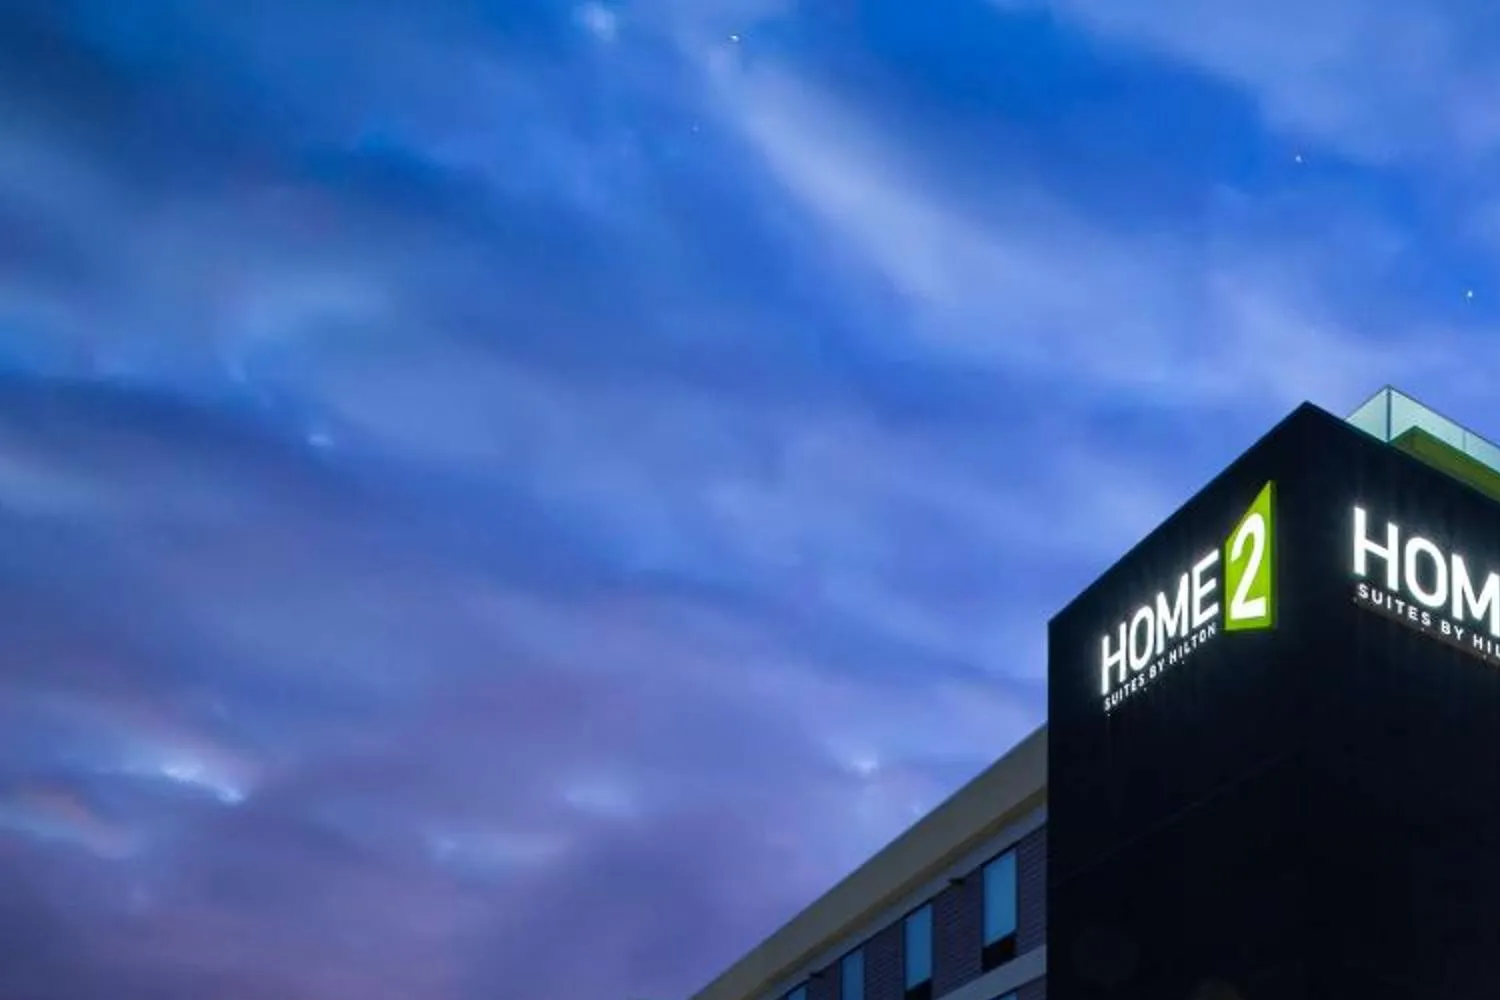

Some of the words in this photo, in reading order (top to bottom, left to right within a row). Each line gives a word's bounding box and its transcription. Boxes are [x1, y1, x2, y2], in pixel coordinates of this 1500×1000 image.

[1101, 549, 1219, 695] HOME
[1358, 584, 1431, 627] SUITES
[1440, 620, 1465, 642] BY
[1104, 674, 1145, 711] SUITES
[1148, 657, 1166, 679] BY
[1169, 622, 1217, 664] HILTON
